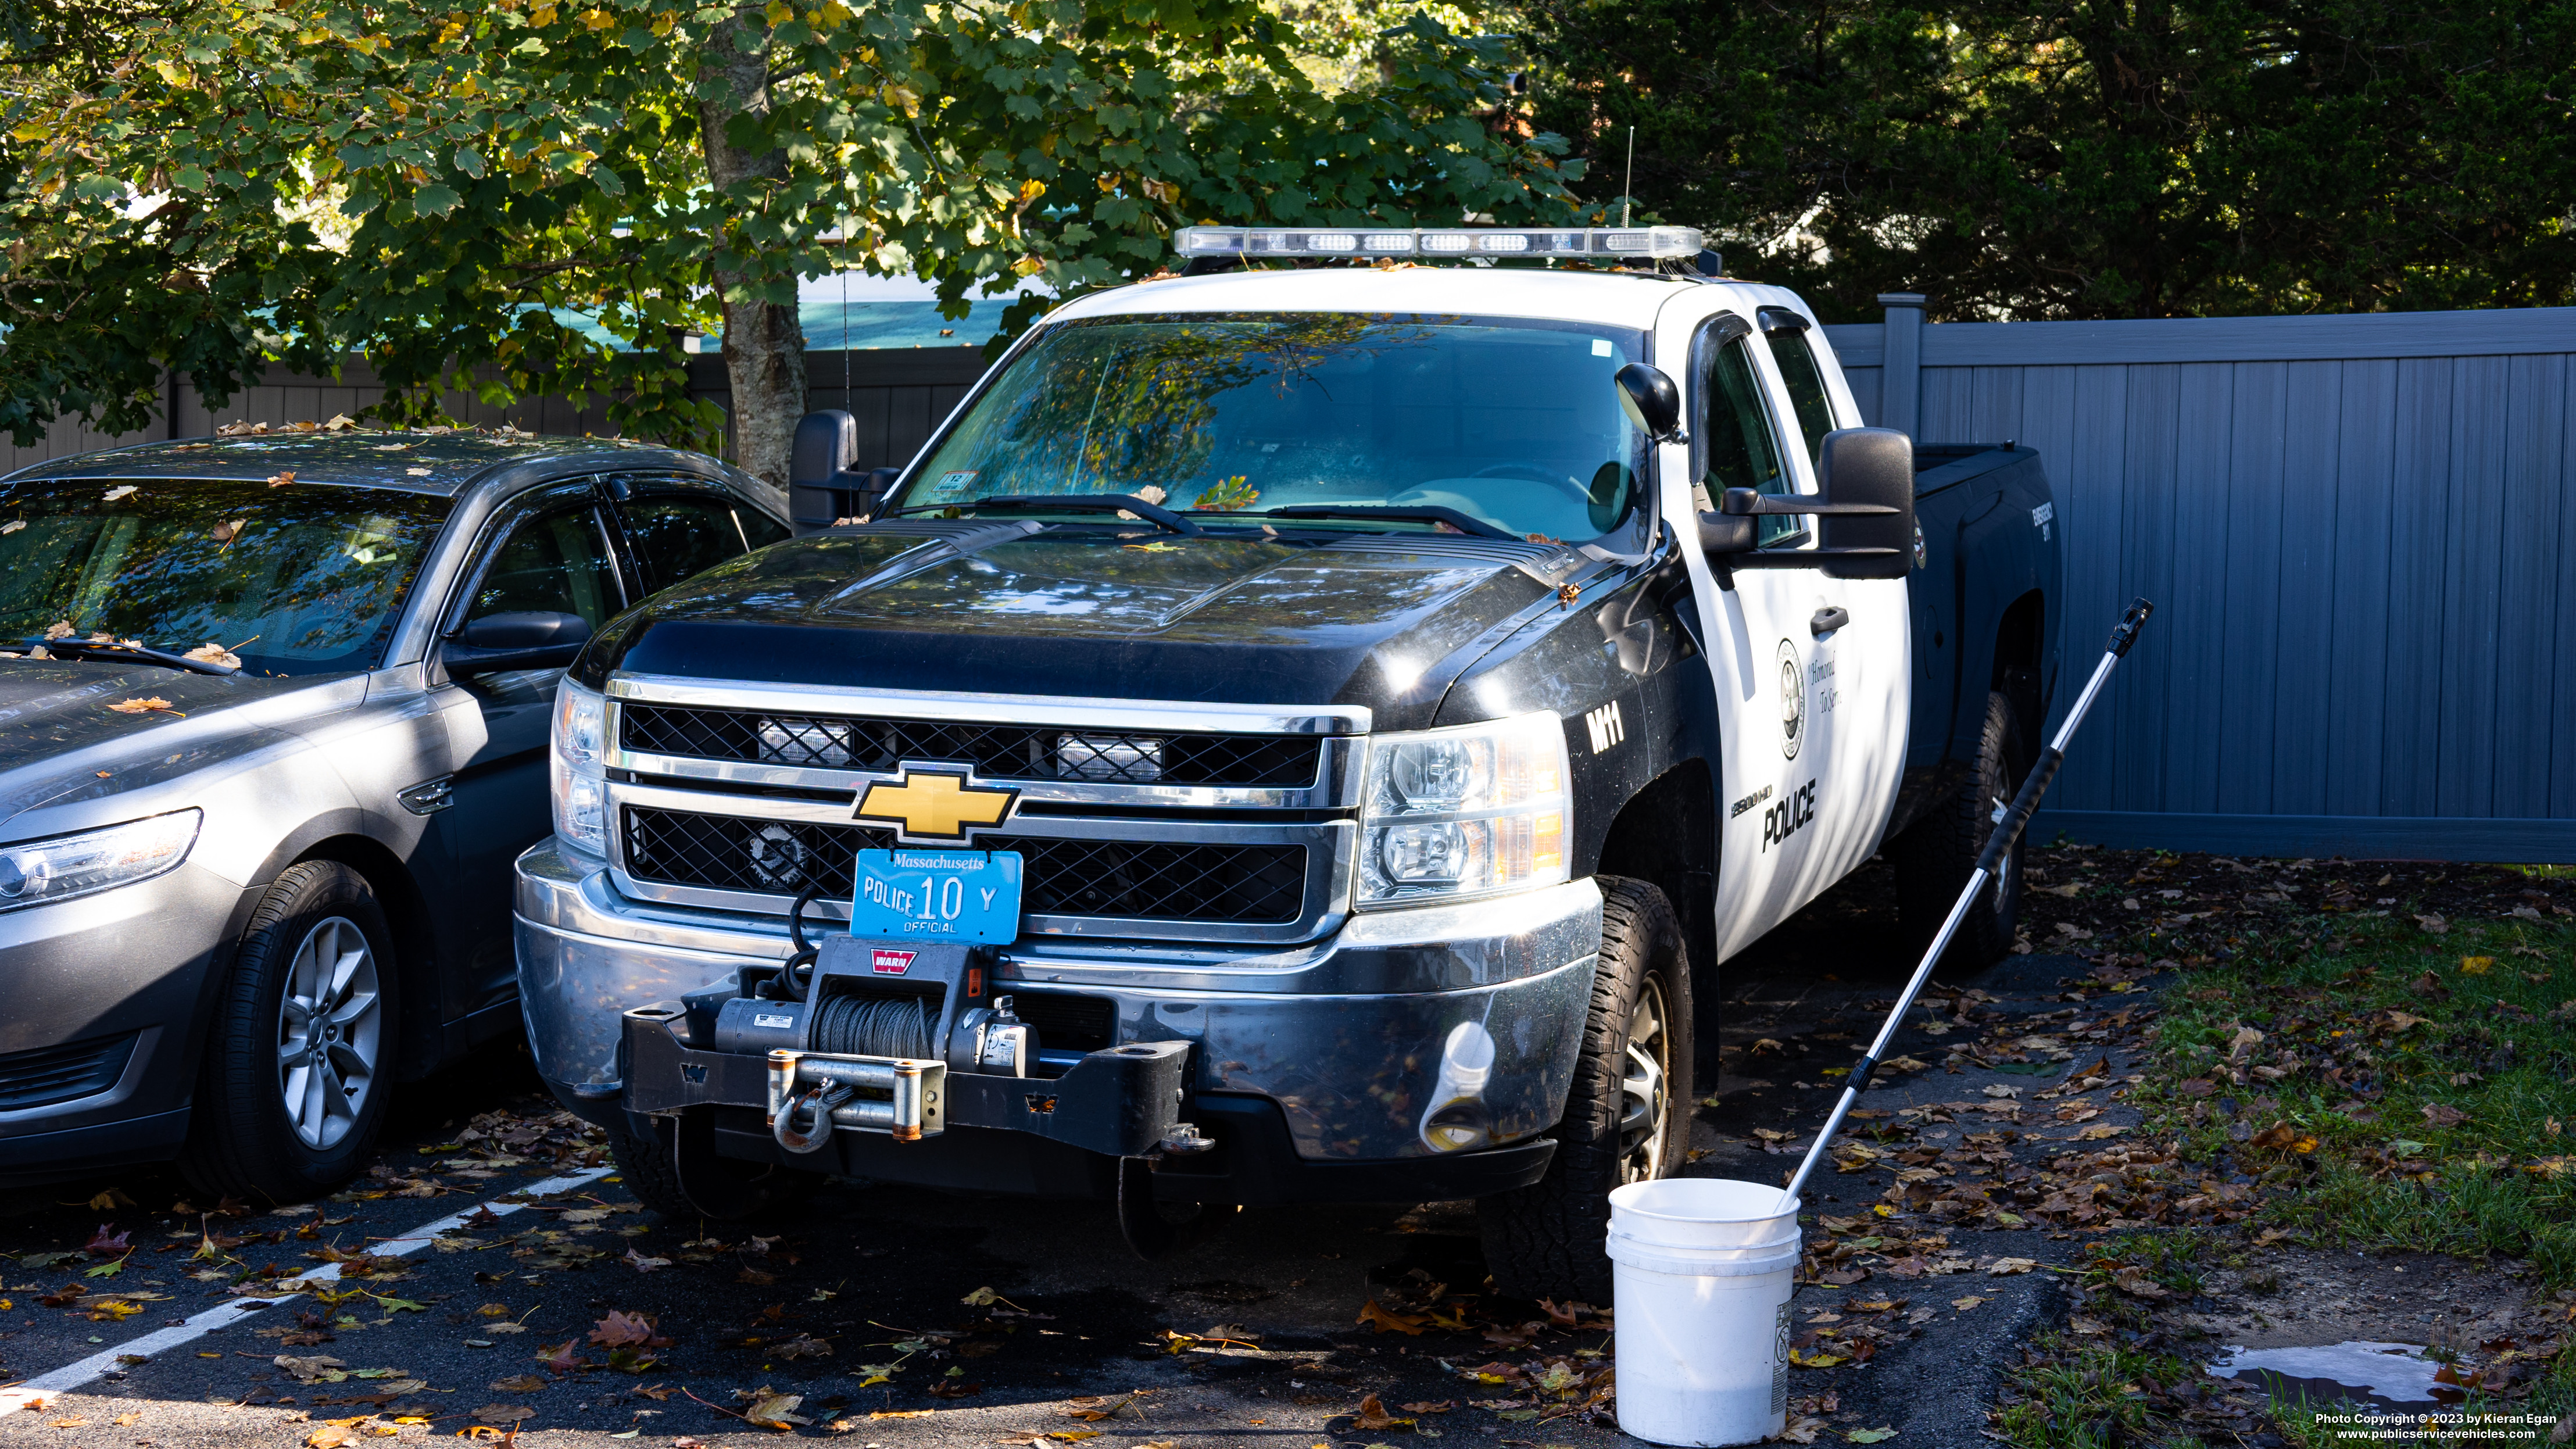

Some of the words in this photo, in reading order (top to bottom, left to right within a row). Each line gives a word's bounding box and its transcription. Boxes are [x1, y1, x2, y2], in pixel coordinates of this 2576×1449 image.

[1819, 688, 1827, 713] To
[1586, 700, 1624, 754] M11
[1762, 778, 1816, 854] POLICE
[893, 853, 985, 870] Massachusetts
[864, 875, 916, 918] POLICE
[917, 876, 964, 921] 10
[980, 886, 998, 911] Y
[904, 921, 958, 934] OFFICIAL
[875, 956, 907, 967] WARN
